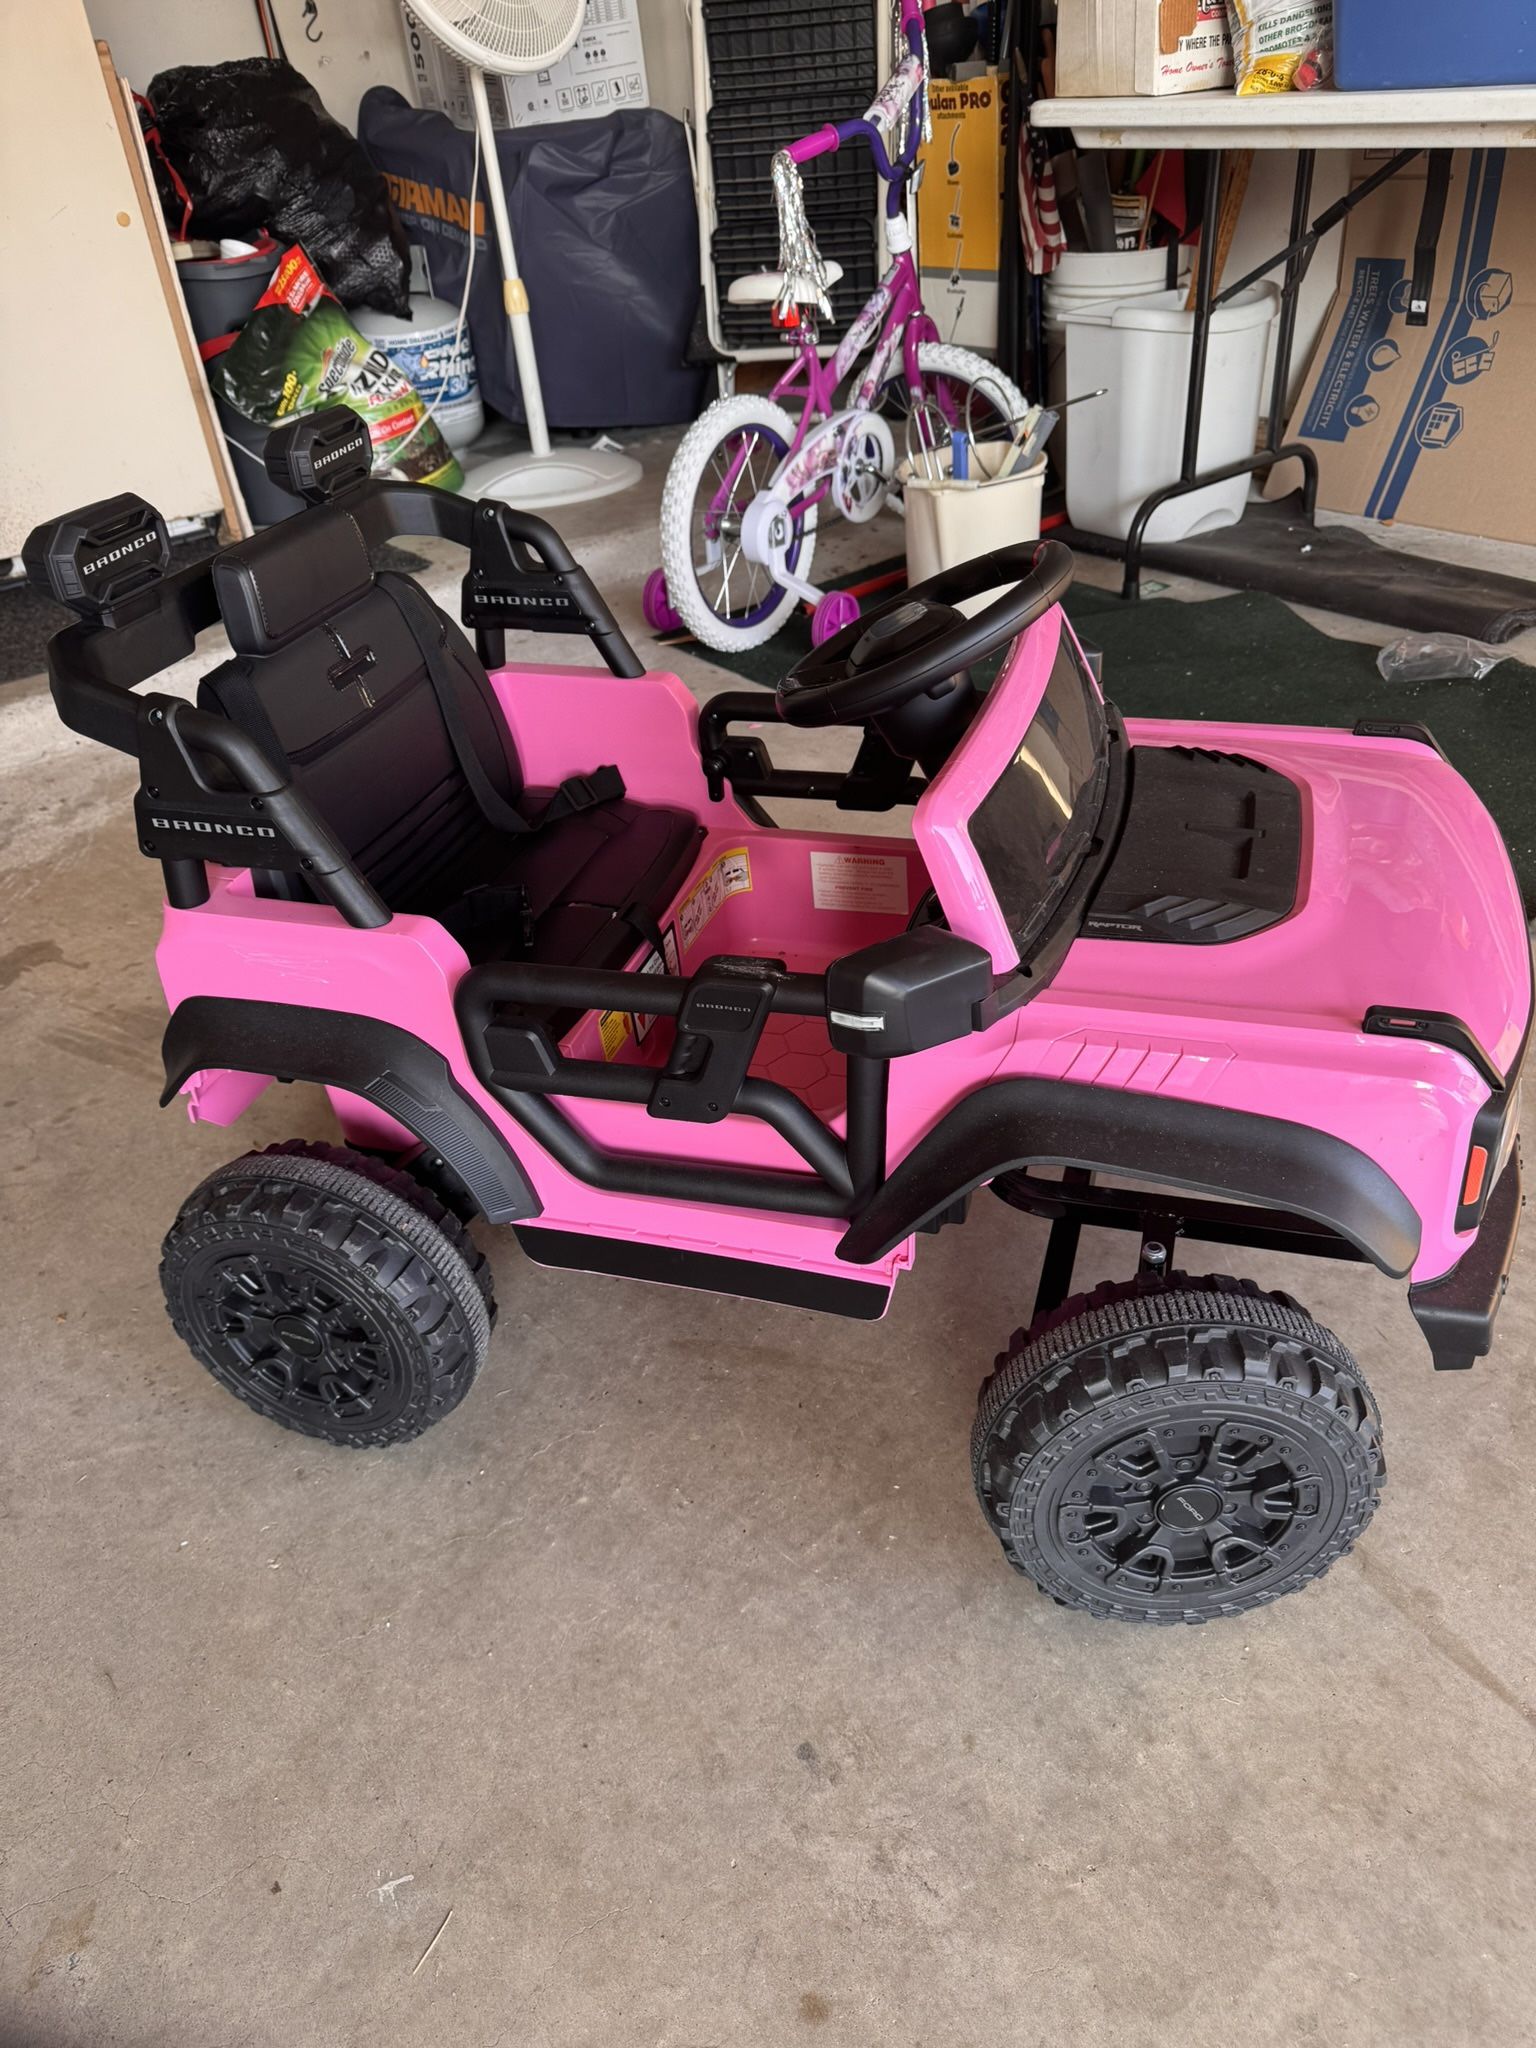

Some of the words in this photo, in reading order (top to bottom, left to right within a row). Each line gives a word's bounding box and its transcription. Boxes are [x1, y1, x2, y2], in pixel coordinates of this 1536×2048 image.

[1258, 19, 1278, 32] KILLS
[1186, 36, 1207, 51] WHERE
[1209, 34, 1220, 48] THE
[1259, 29, 1283, 45] OTHER
[1161, 64, 1183, 77] Home
[929, 93, 957, 111] ulan
[960, 90, 991, 110] PRO
[1351, 310, 1371, 350] WATER
[1319, 360, 1352, 430] ELECTRICITY
[313, 437, 364, 470] BRONCO
[83, 530, 157, 576] BRONCO
[474, 594, 569, 607] BRONCO
[151, 817, 276, 839] BRONCO
[843, 856, 886, 866] WARNING
[1088, 920, 1144, 932] RAPTOR
[696, 1003, 751, 1013] BRONCO
[1176, 1496, 1205, 1521] FORD
